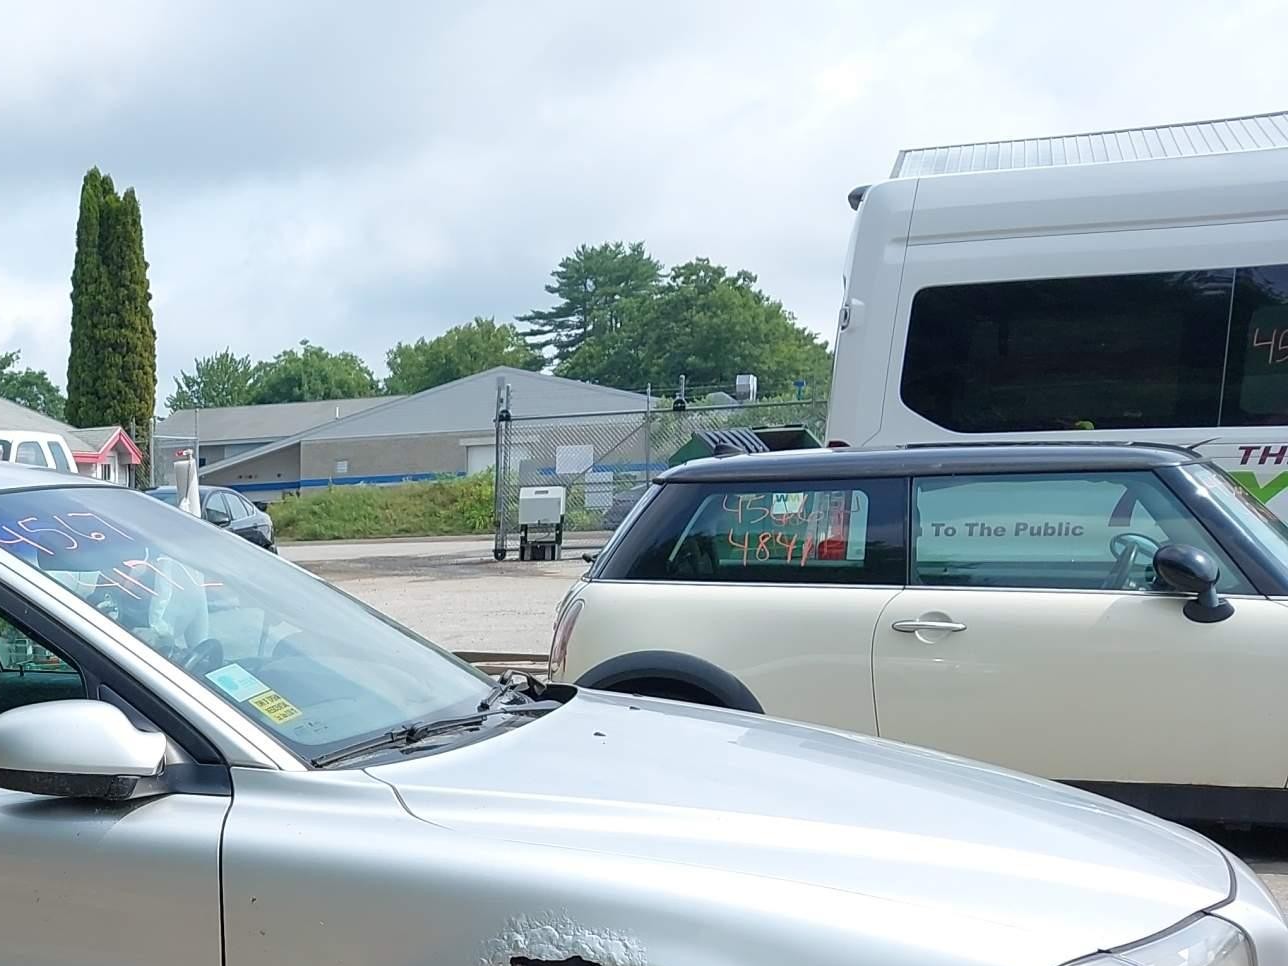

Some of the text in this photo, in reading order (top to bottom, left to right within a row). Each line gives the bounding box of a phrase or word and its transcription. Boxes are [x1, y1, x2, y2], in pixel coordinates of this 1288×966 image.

[1238, 445, 1288, 466] TH
[931, 522, 957, 537] To
[964, 522, 1007, 537] The
[1014, 521, 1085, 537] Public
